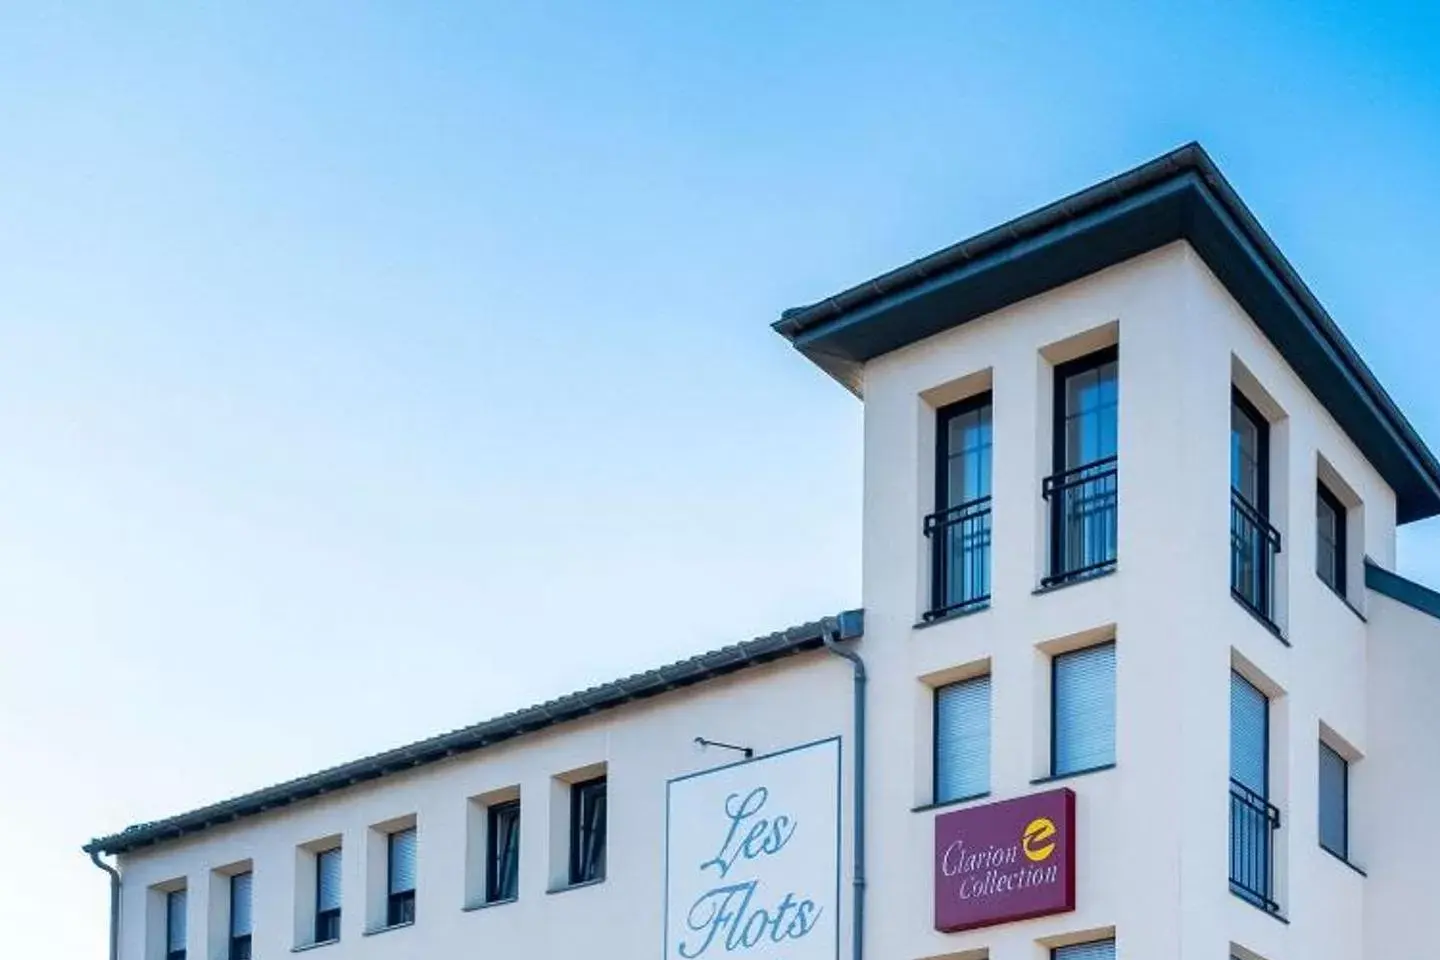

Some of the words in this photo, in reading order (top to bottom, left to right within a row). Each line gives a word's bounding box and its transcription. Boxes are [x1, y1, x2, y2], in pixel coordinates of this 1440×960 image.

[700, 787, 797, 879] Les
[942, 840, 1017, 876] Clarion
[679, 880, 823, 958] Flots
